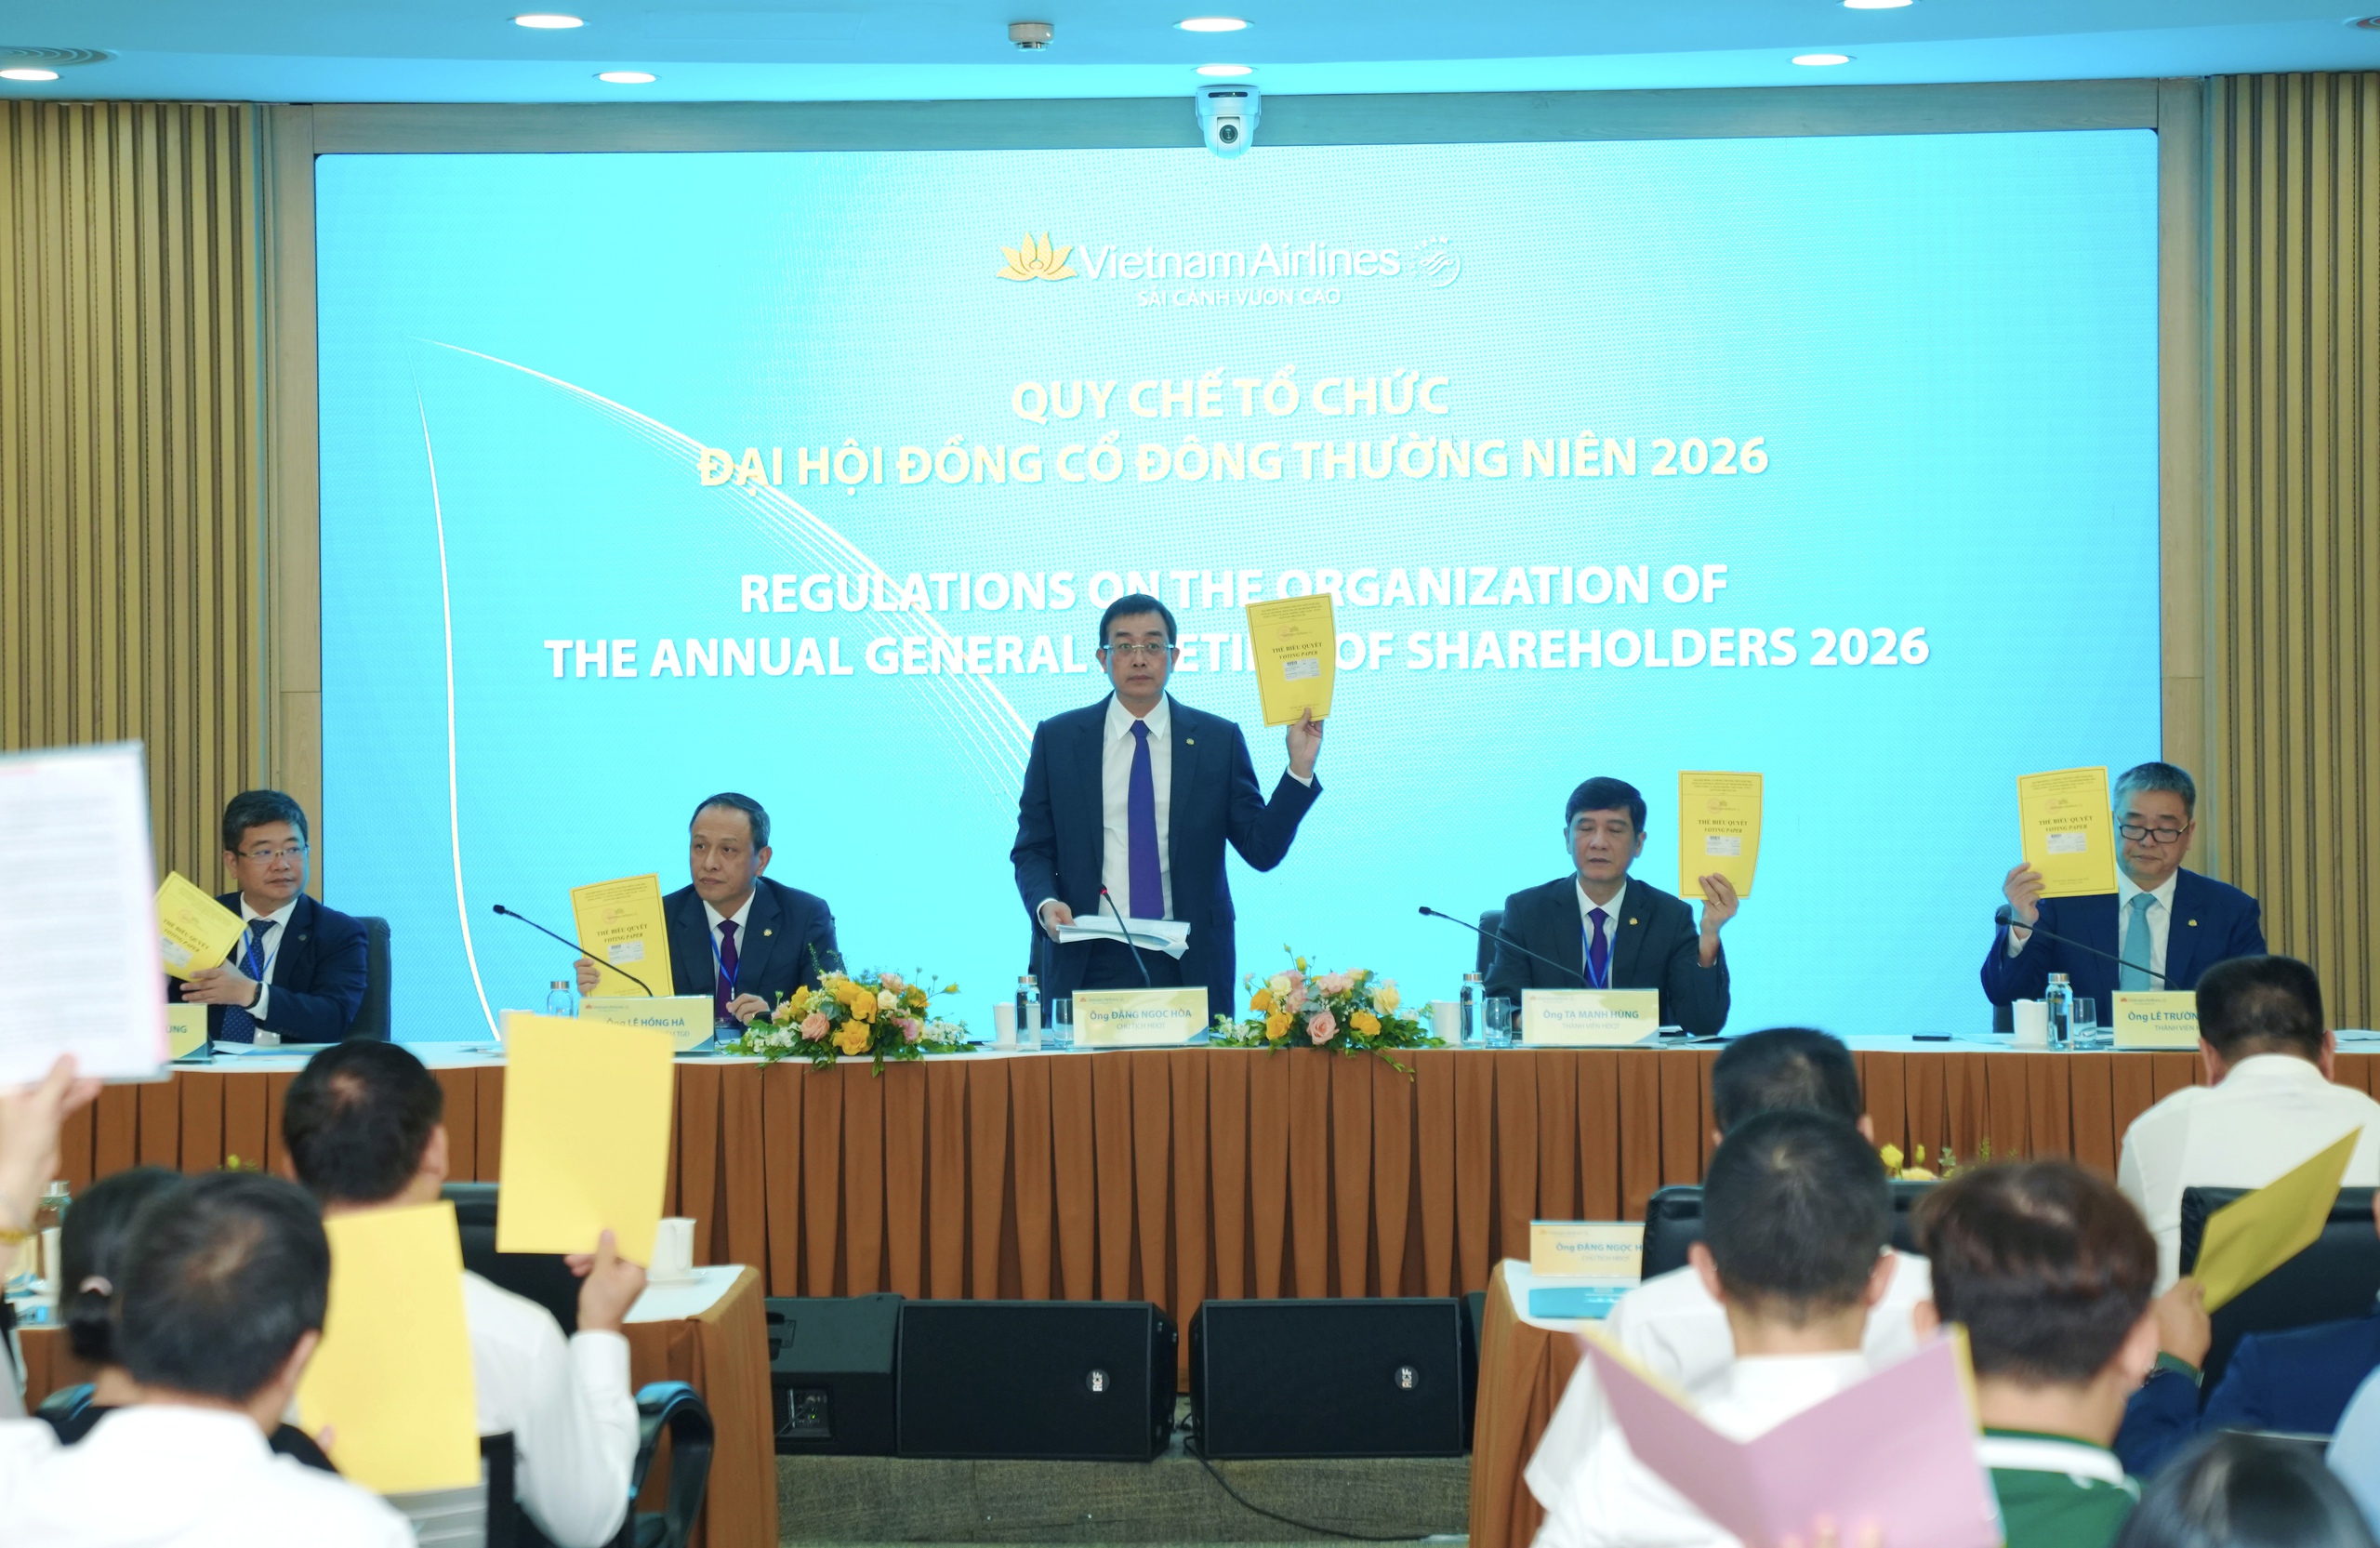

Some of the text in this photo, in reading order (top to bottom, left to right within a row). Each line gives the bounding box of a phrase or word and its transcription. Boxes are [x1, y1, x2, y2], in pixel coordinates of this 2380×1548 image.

[1079, 244, 1245, 281] Vietnam
[1250, 240, 1401, 278] Airlines
[1300, 287, 1342, 305] CAO
[1012, 364, 1449, 425] QUY CHẾ TỔ CHỨC
[696, 430, 1769, 496] ĐẠI HỘI ĐỒNG CỔ ĐÔNG THƯỜNG NIÊN 2026
[742, 564, 1728, 613] REGULATIONS ON THE ORGANIZATION OF
[544, 640, 638, 677] THE
[651, 638, 853, 676] ANNUAL
[866, 635, 1088, 675] GENERAL
[1335, 631, 1395, 670] OF
[1408, 628, 1796, 669] SHAREHOLDERS
[1811, 628, 1929, 666] 2026
[164, 928, 182, 943] VOTING
[182, 940, 201, 952] PAPER
[628, 1017, 639, 1027] LÊ
[641, 1016, 669, 1027] HỒNG
[671, 1016, 685, 1027] HÀ
[1090, 1008, 1192, 1022] Ông ĐẶNG NGỌC HÒA
[1543, 1008, 1639, 1022] Ông TẠ MẠNH HÙNG
[2128, 1011, 2199, 1022] Ông LÊ TRƯỜN
[1556, 1242, 1576, 1252] Ông
[1092, 1371, 1103, 1392] RCF
[1402, 1368, 1412, 1388] RCF
